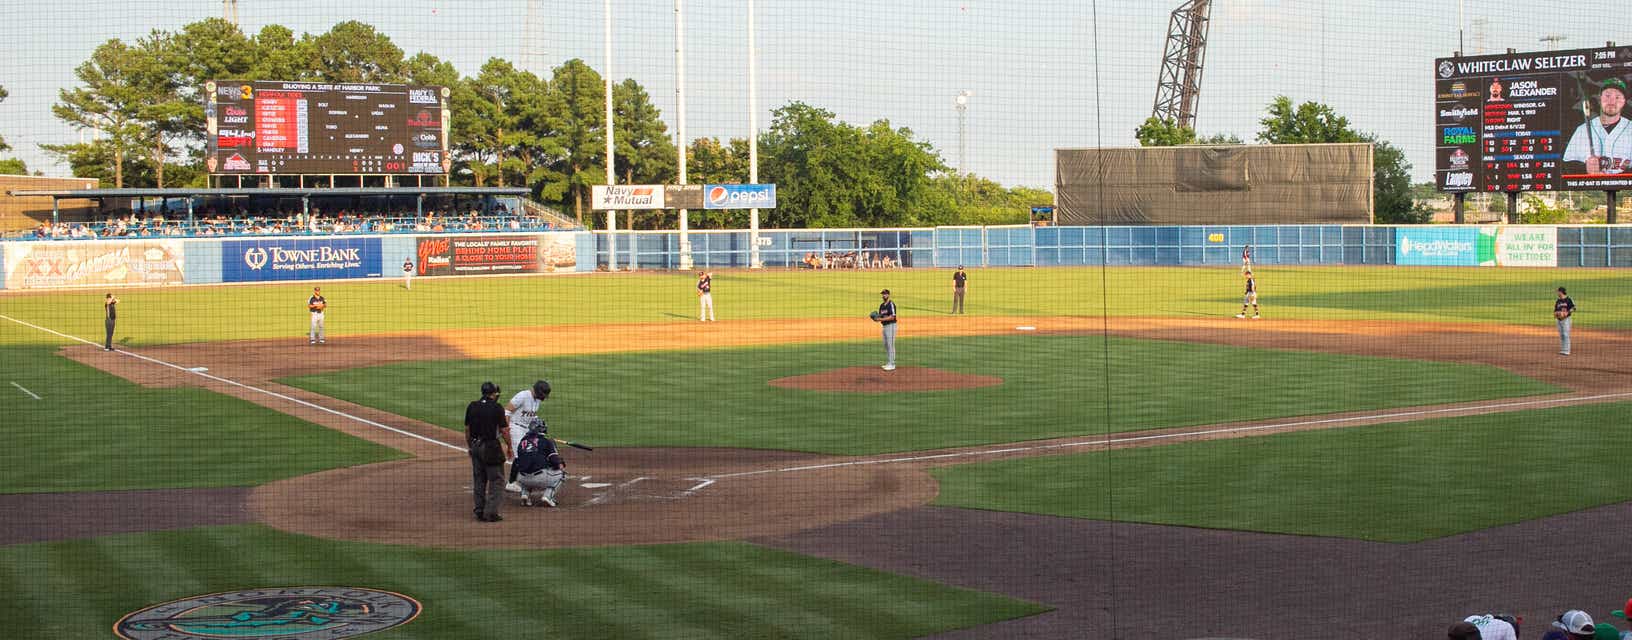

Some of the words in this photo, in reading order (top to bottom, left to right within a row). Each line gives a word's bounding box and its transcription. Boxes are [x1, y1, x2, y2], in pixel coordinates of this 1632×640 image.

[1458, 58, 1532, 74] WHITECLAW
[1534, 55, 1586, 70] SELTZER
[1509, 80, 1537, 90] JASON
[240, 85, 252, 99] 3
[1510, 88, 1557, 97] ALEXANDER
[1440, 108, 1478, 118] Smithfield
[1444, 127, 1474, 136] ROYAL
[1444, 135, 1476, 144] FARMS
[413, 152, 439, 162] DICK'S
[1446, 171, 1473, 186] Langley
[606, 186, 632, 196] Navy
[730, 189, 769, 203] pepsi
[614, 196, 652, 205] Mutual
[1208, 233, 1224, 242] 400
